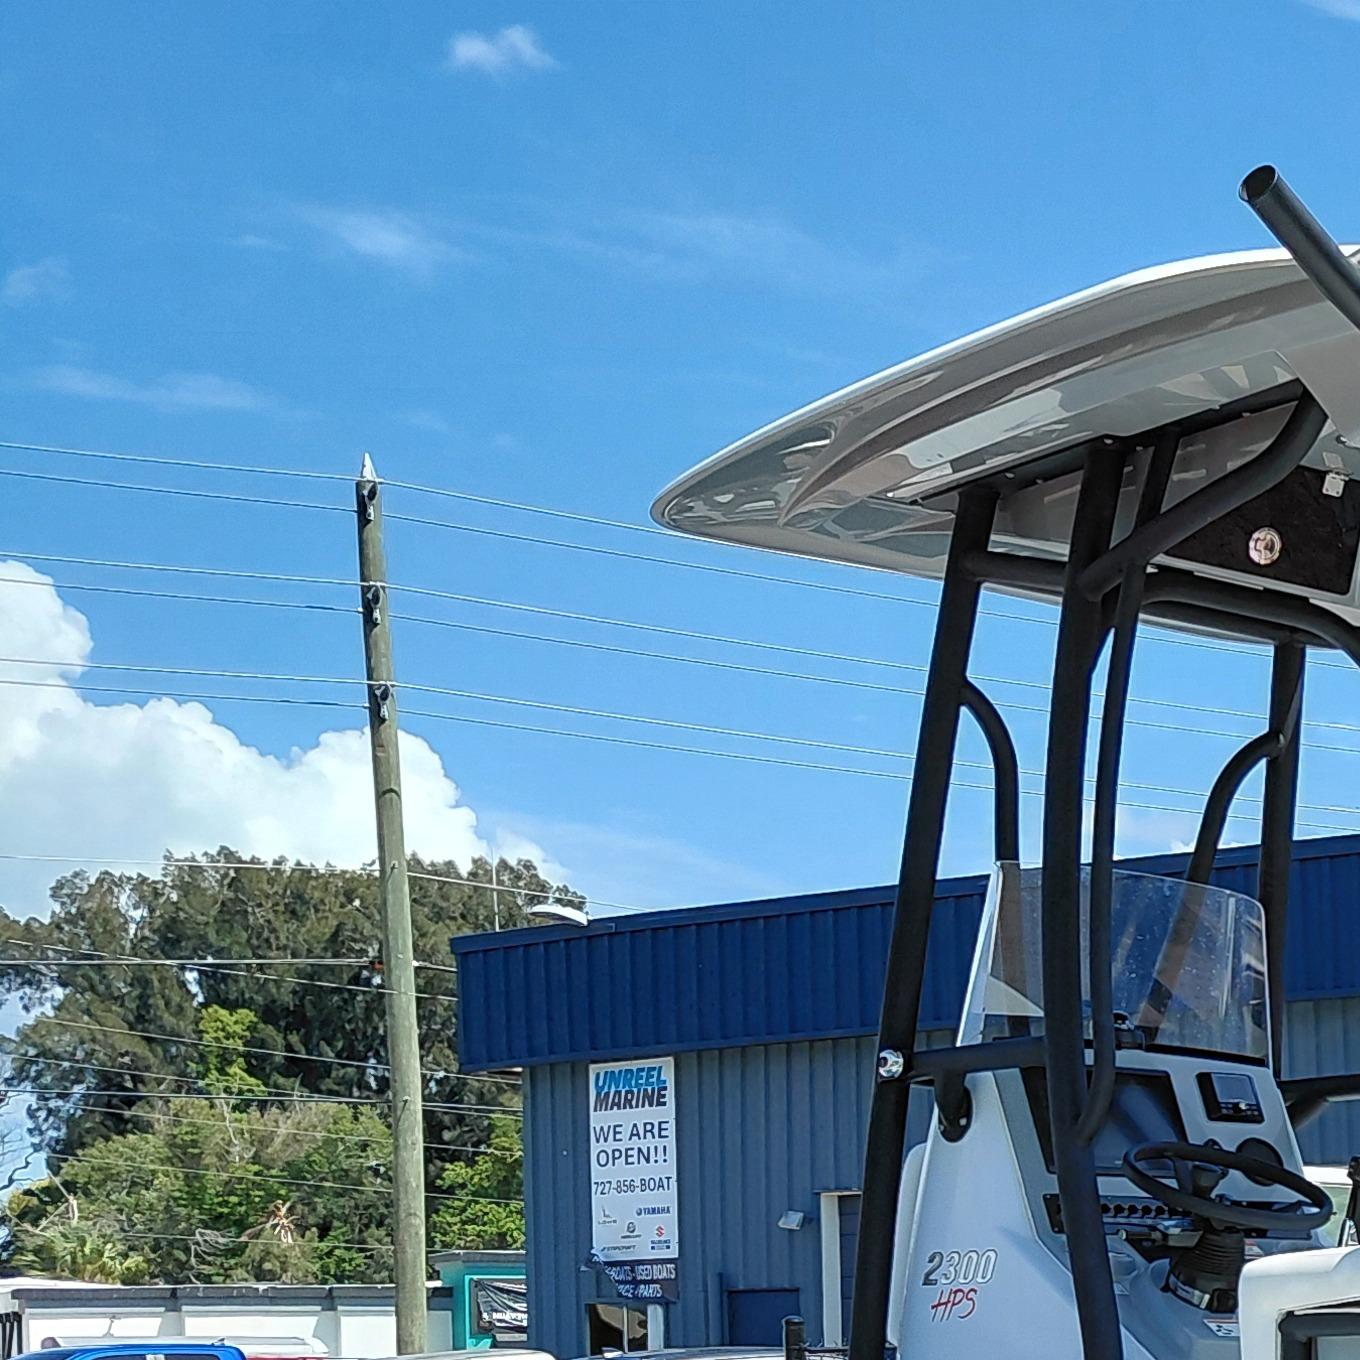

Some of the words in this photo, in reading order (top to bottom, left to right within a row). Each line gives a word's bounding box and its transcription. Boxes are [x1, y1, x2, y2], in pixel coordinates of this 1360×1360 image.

[594, 1066, 667, 1092] UNREEL
[593, 1086, 668, 1112] MARINE
[593, 1124, 623, 1144] WE
[628, 1121, 669, 1141] ARE
[596, 1145, 667, 1168] OPEN!!
[593, 1176, 672, 1196] 727-856-BOAT
[642, 1206, 671, 1215] YAMAHA
[635, 1265, 653, 1279] USED
[653, 1264, 676, 1278] BOATS
[922, 1249, 998, 1286] 2300
[931, 1288, 978, 1322] HPS
